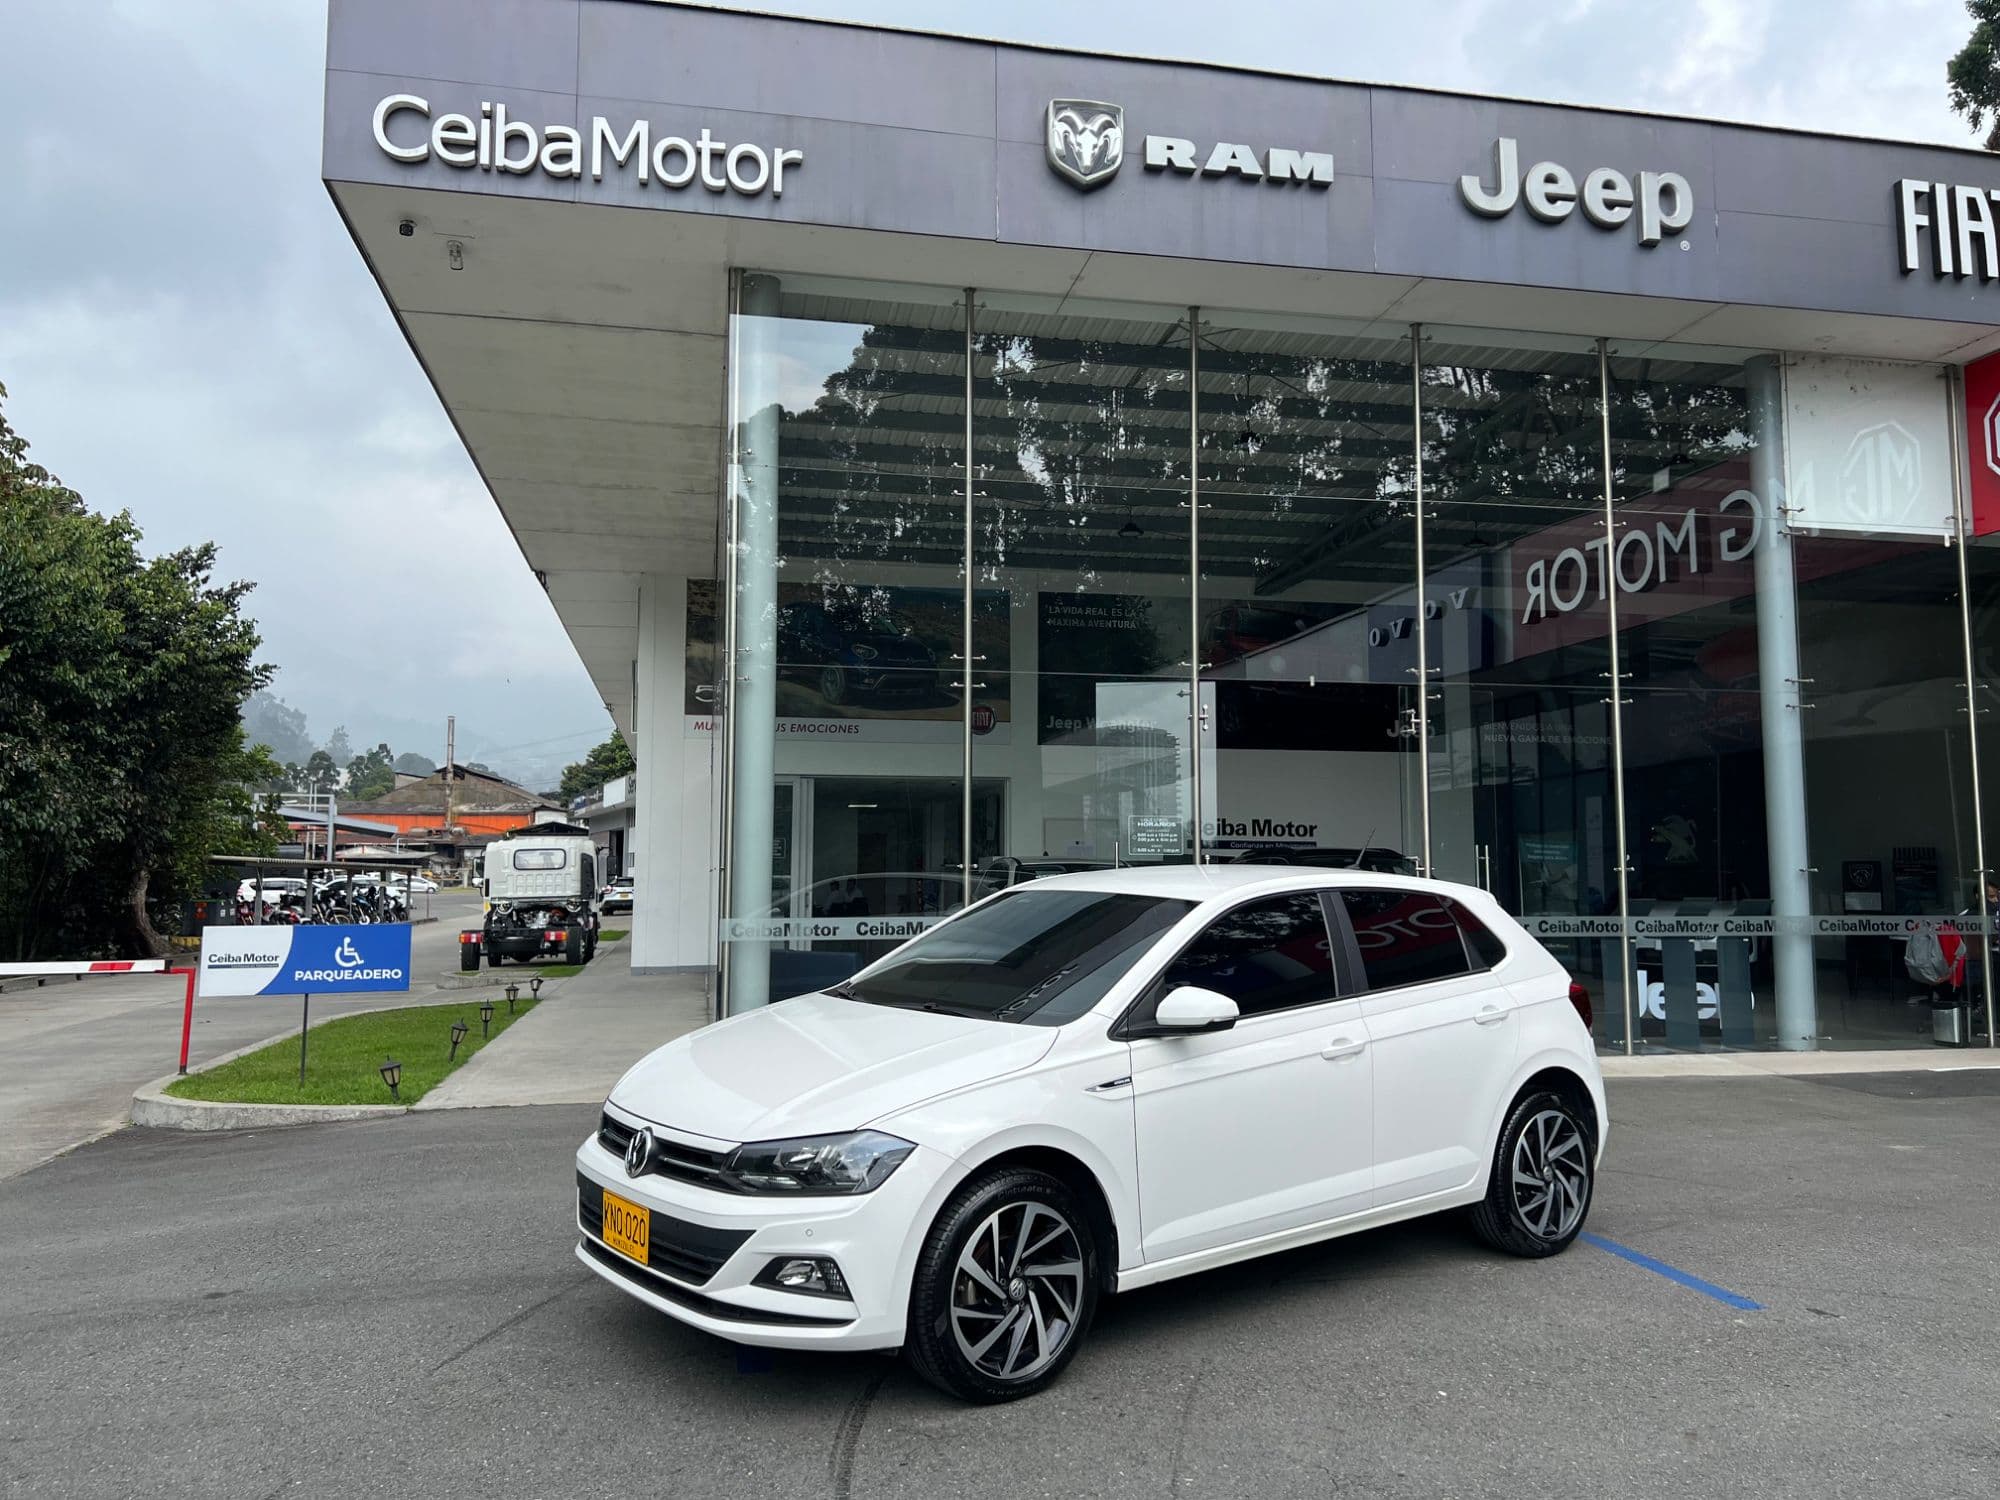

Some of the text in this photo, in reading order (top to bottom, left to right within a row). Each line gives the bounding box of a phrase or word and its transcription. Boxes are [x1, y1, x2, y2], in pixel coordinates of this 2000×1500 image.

[1143, 135, 1335, 187] RAM
[1457, 137, 1694, 248] Jeep
[1896, 178, 2000, 280] FIA
[1062, 606, 1083, 616] VIDA
[1085, 607, 1108, 616] REAL
[1111, 608, 1123, 617] ES
[1087, 619, 1137, 629] AVENTURA
[790, 723, 860, 734] EMOCIONES
[1046, 714, 1082, 731] Jeep
[1484, 734, 1515, 744] NUEVA
[1563, 735, 1613, 745] EMOCIONE
[1202, 818, 1318, 837] eiba Motor
[294, 968, 403, 982] PARQUEADERO
[626, 1211, 646, 1247] 020
